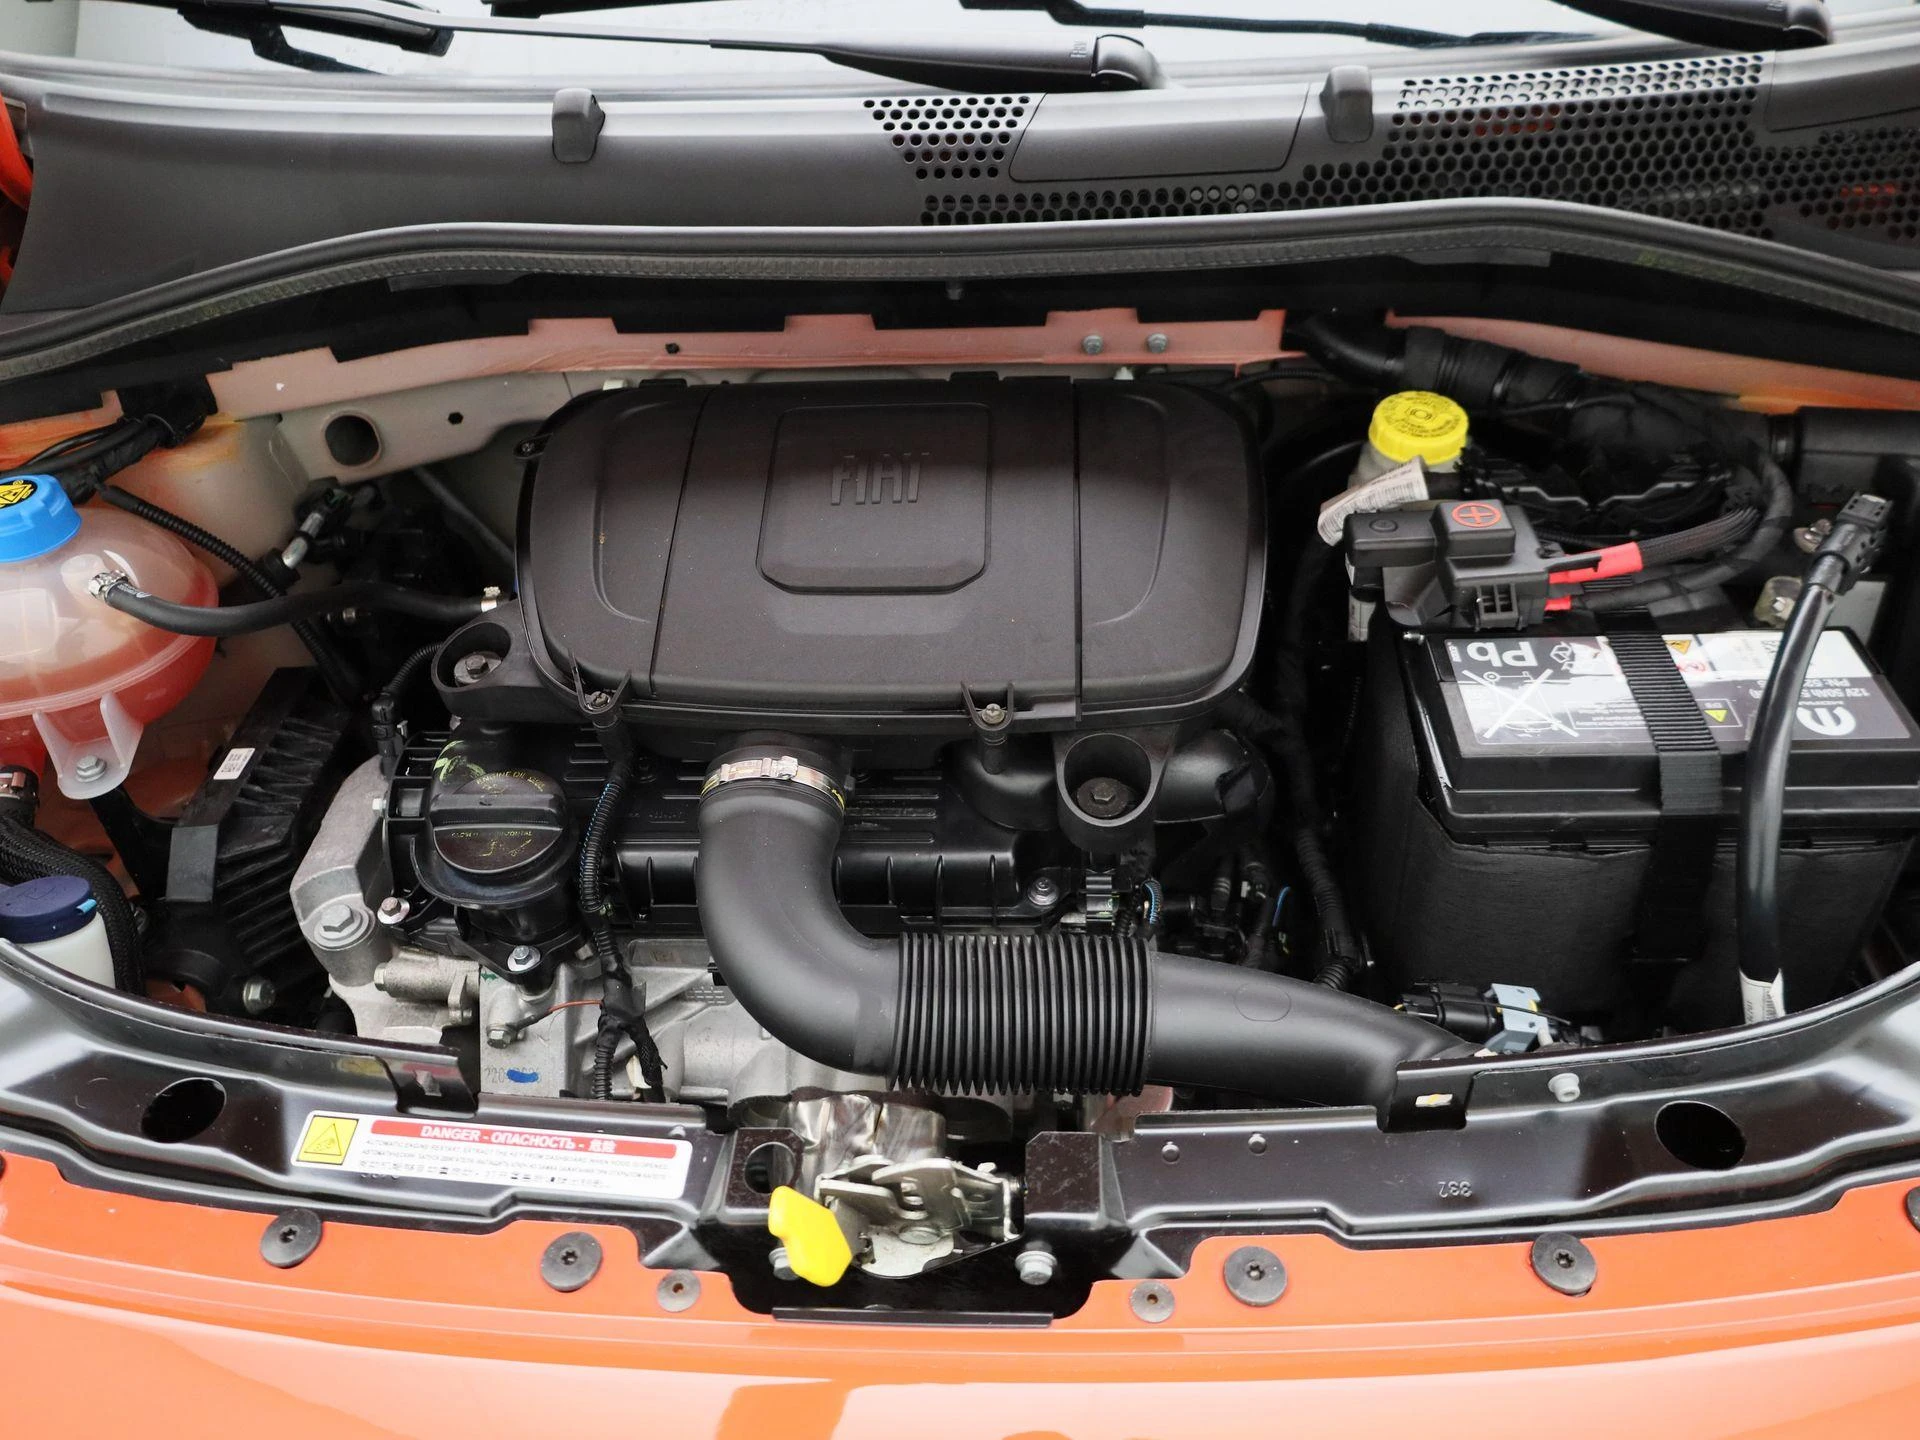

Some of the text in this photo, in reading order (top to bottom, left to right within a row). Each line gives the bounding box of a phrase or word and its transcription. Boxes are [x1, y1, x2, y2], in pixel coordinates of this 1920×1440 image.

[831, 453, 930, 505] FIAT
[1466, 642, 1538, 667] Pb
[420, 1126, 481, 1142] DANGER
[491, 1131, 575, 1150] ОПАСНОСТЬ
